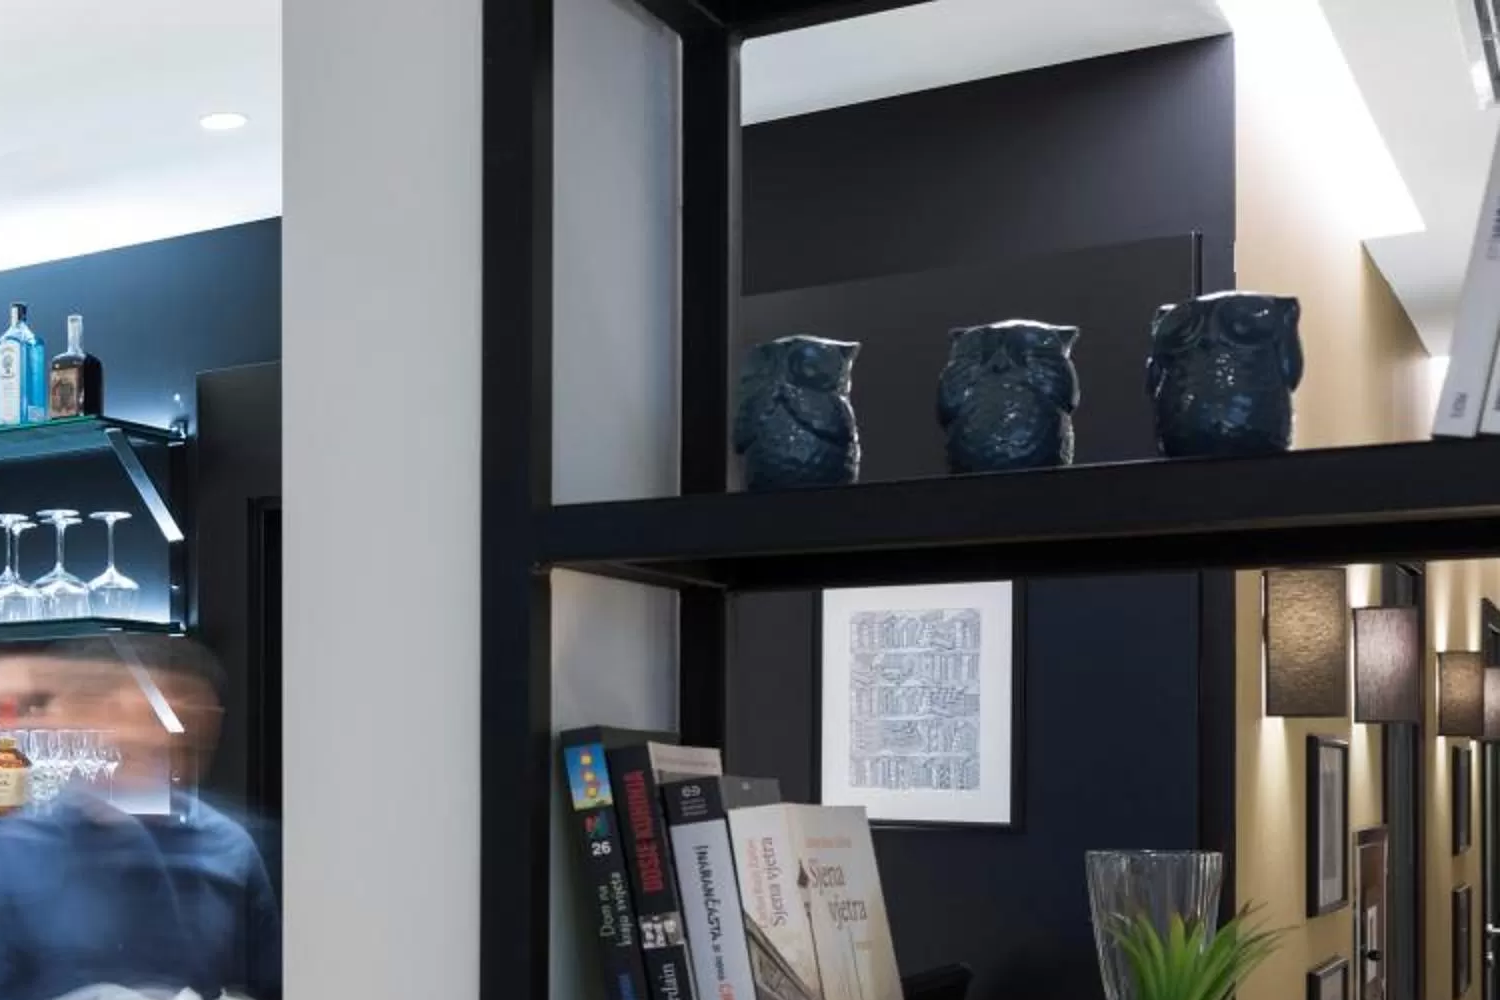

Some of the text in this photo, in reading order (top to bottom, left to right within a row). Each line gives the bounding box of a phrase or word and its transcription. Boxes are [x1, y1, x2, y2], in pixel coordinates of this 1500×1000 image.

[591, 841, 612, 856] 26
[599, 904, 616, 937] Dom
[770, 883, 789, 927] Sjena
